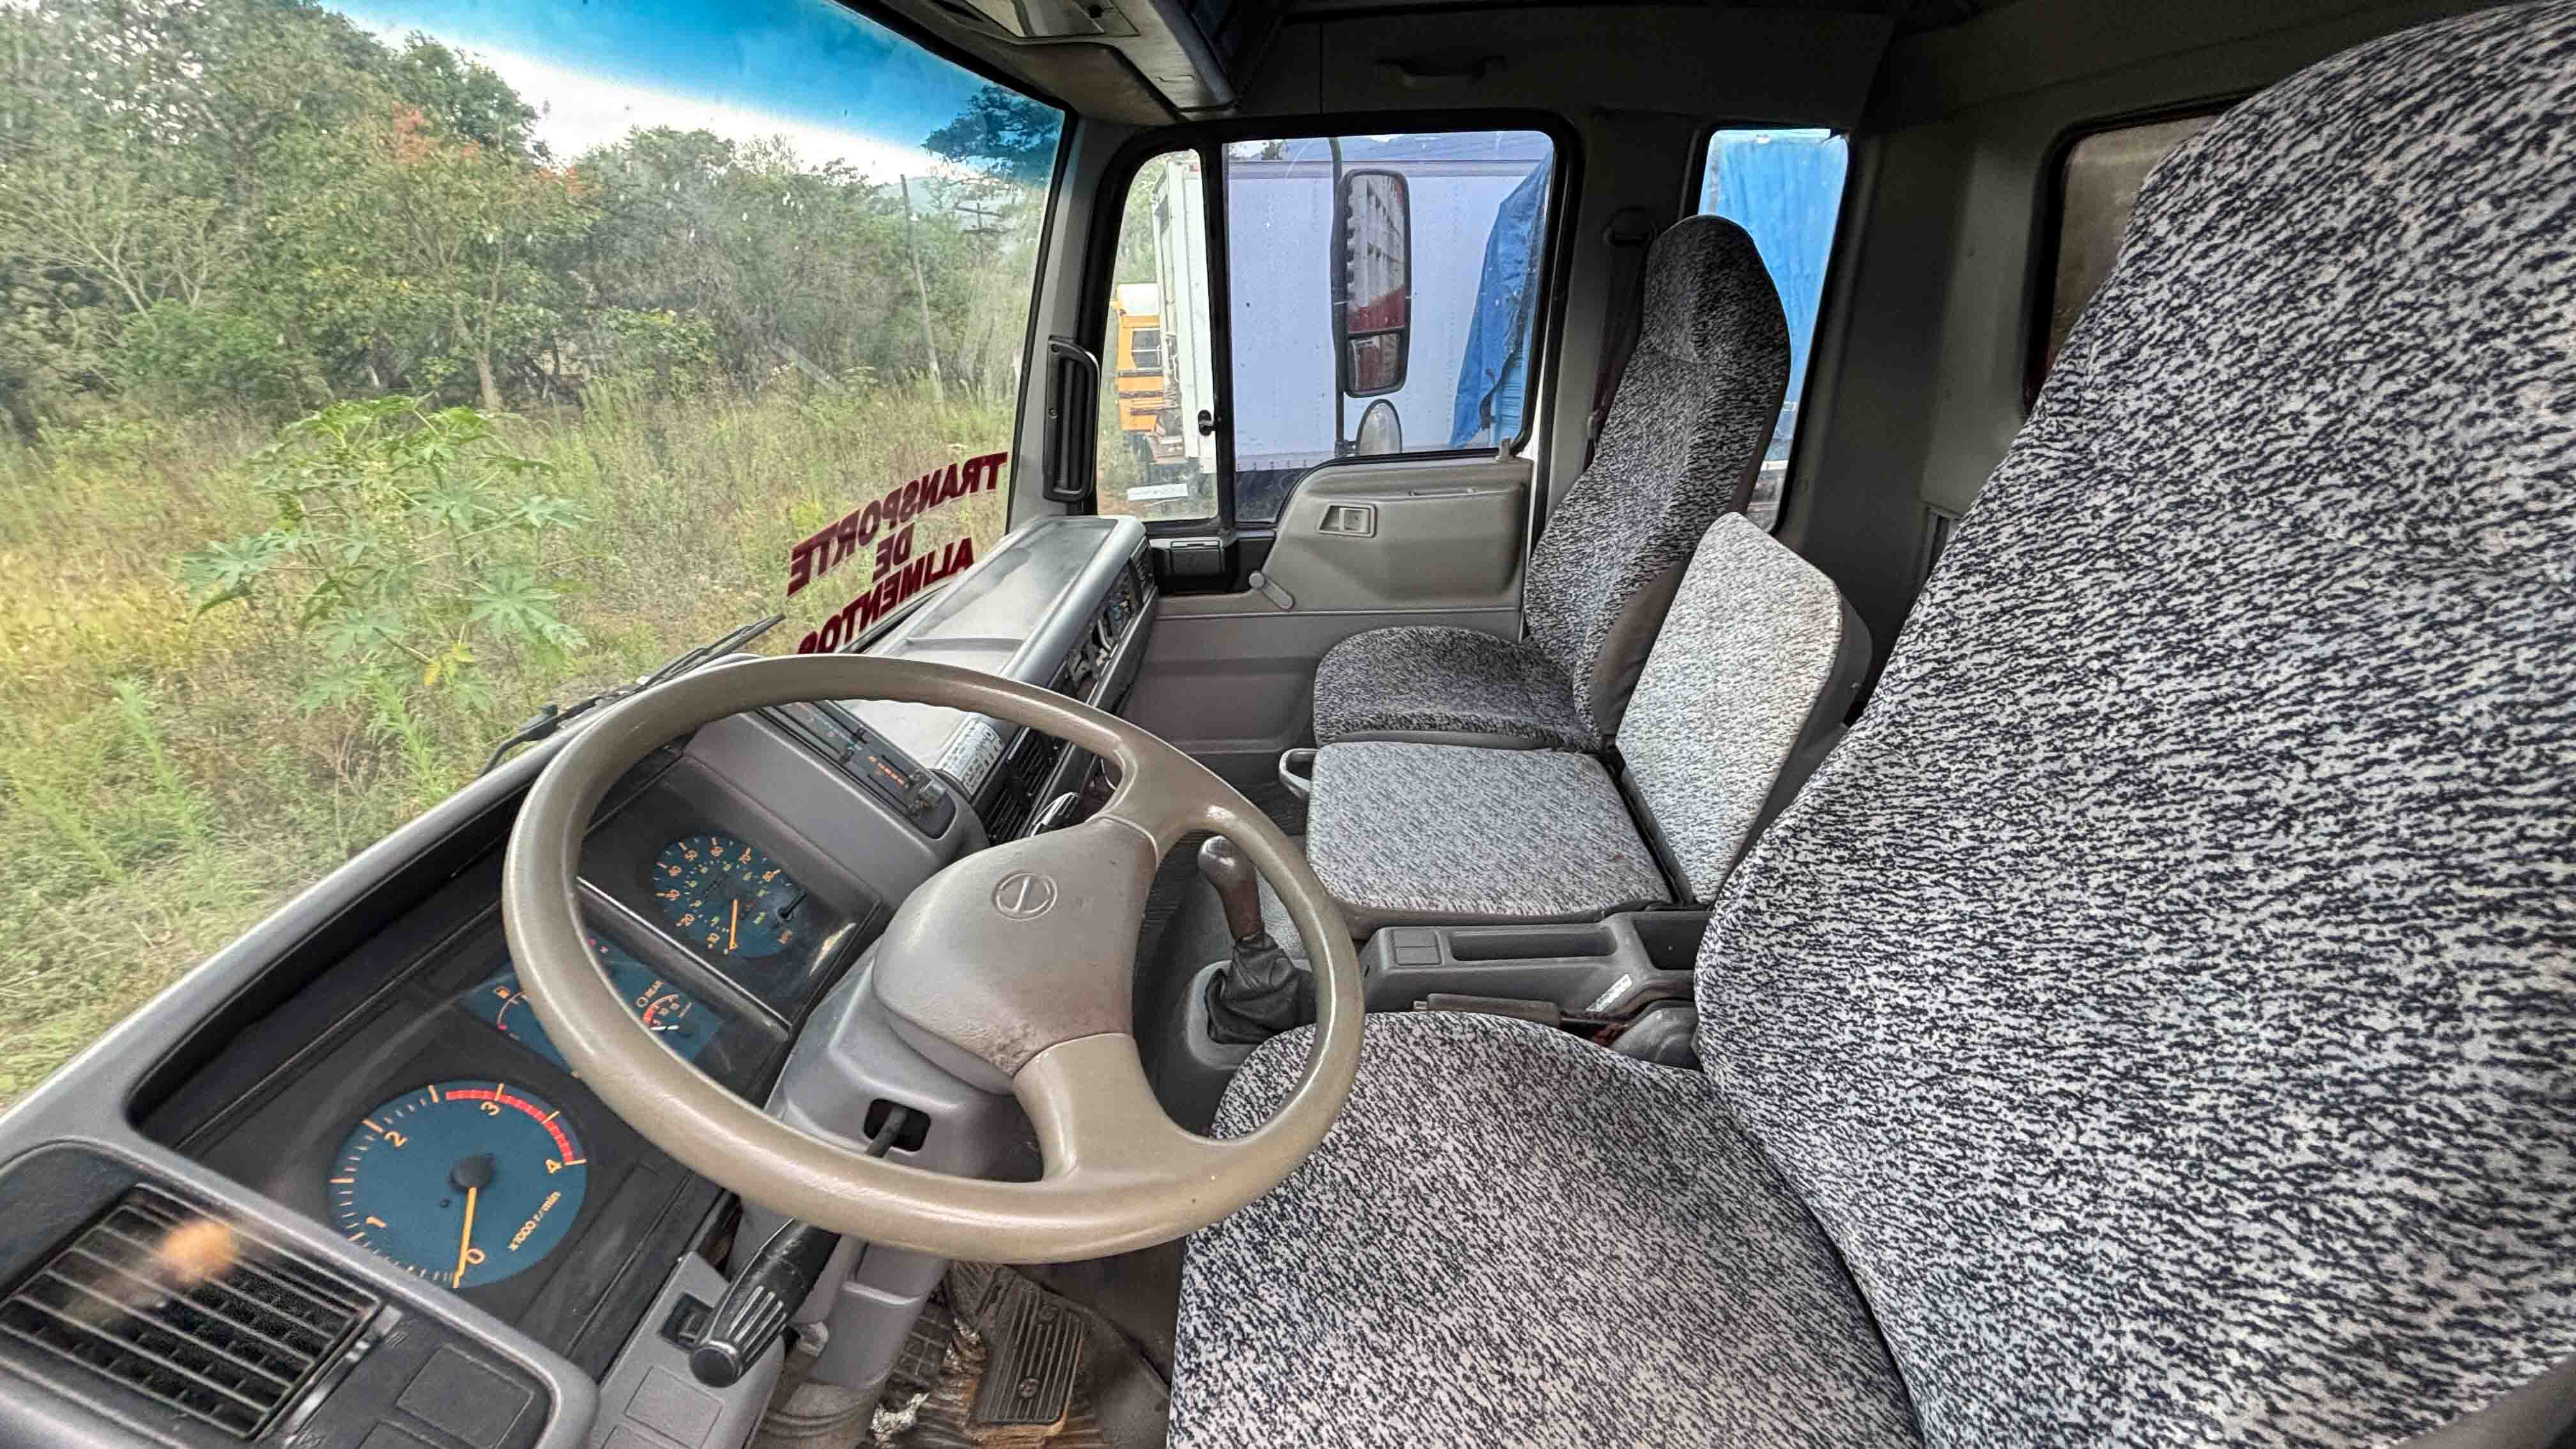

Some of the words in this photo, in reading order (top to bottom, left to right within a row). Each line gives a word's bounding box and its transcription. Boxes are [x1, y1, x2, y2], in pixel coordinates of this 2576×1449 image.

[480, 1101, 501, 1116] 3
[384, 1131, 408, 1147] 2
[545, 1159, 562, 1174] 4
[365, 1216, 387, 1227] 1
[466, 1248, 486, 1265] 0
